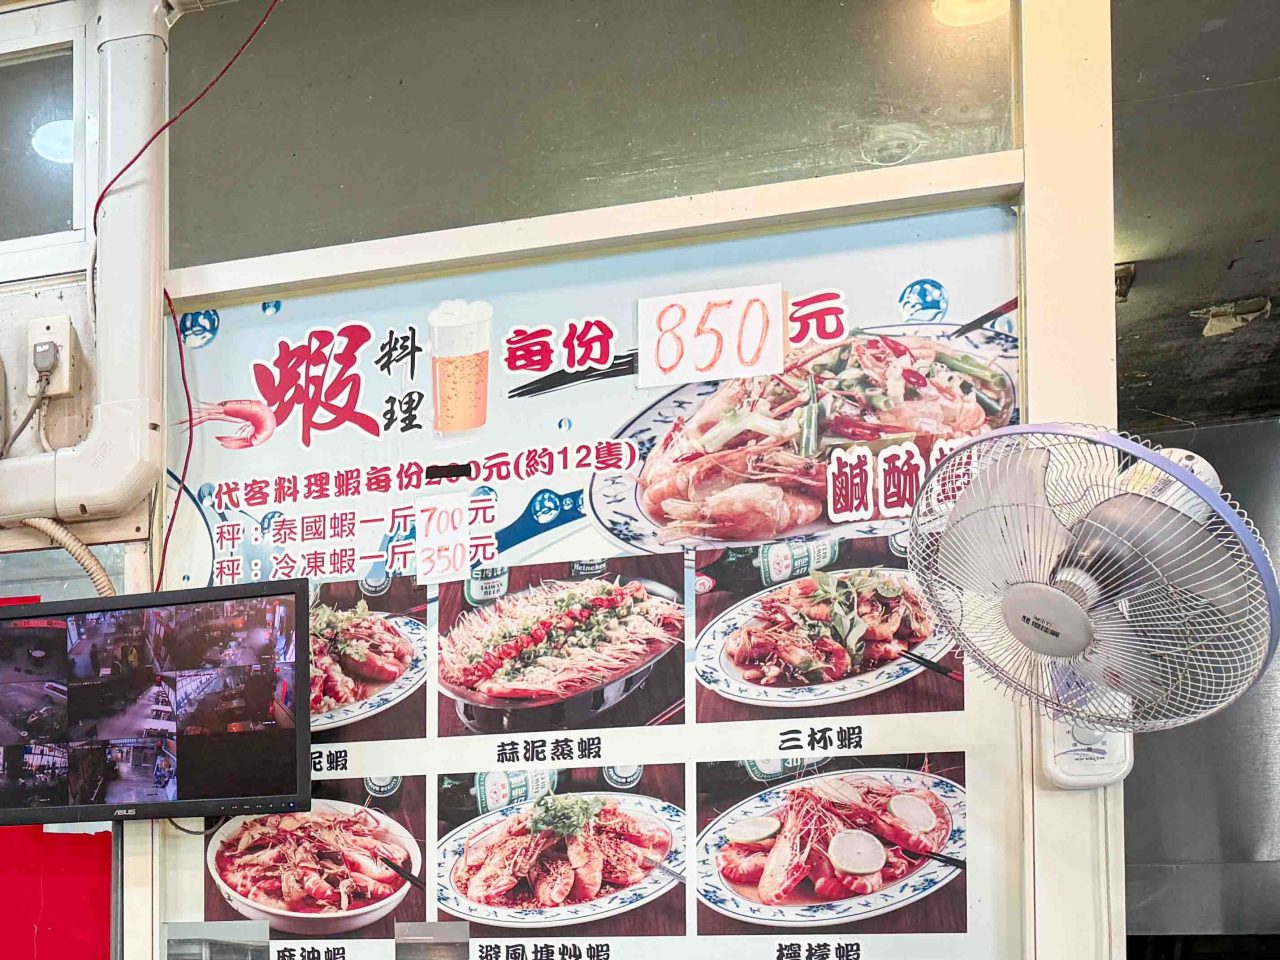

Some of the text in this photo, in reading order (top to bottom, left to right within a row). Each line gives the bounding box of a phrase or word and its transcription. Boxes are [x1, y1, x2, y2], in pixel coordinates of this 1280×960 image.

[789, 292, 845, 344] 元
[505, 320, 613, 371] 每份
[655, 298, 769, 375] 850
[253, 324, 380, 447] 蝦
[214, 441, 637, 511] 代客料理蝦每份0元(約12隻)
[420, 508, 464, 538] 700
[469, 499, 496, 525] 元
[421, 544, 466, 575] 350
[469, 535, 496, 562] 元
[497, 737, 601, 763] 蒜泥蒸蝦
[779, 726, 863, 751] 三杯蝦
[114, 808, 136, 817] ASUS
